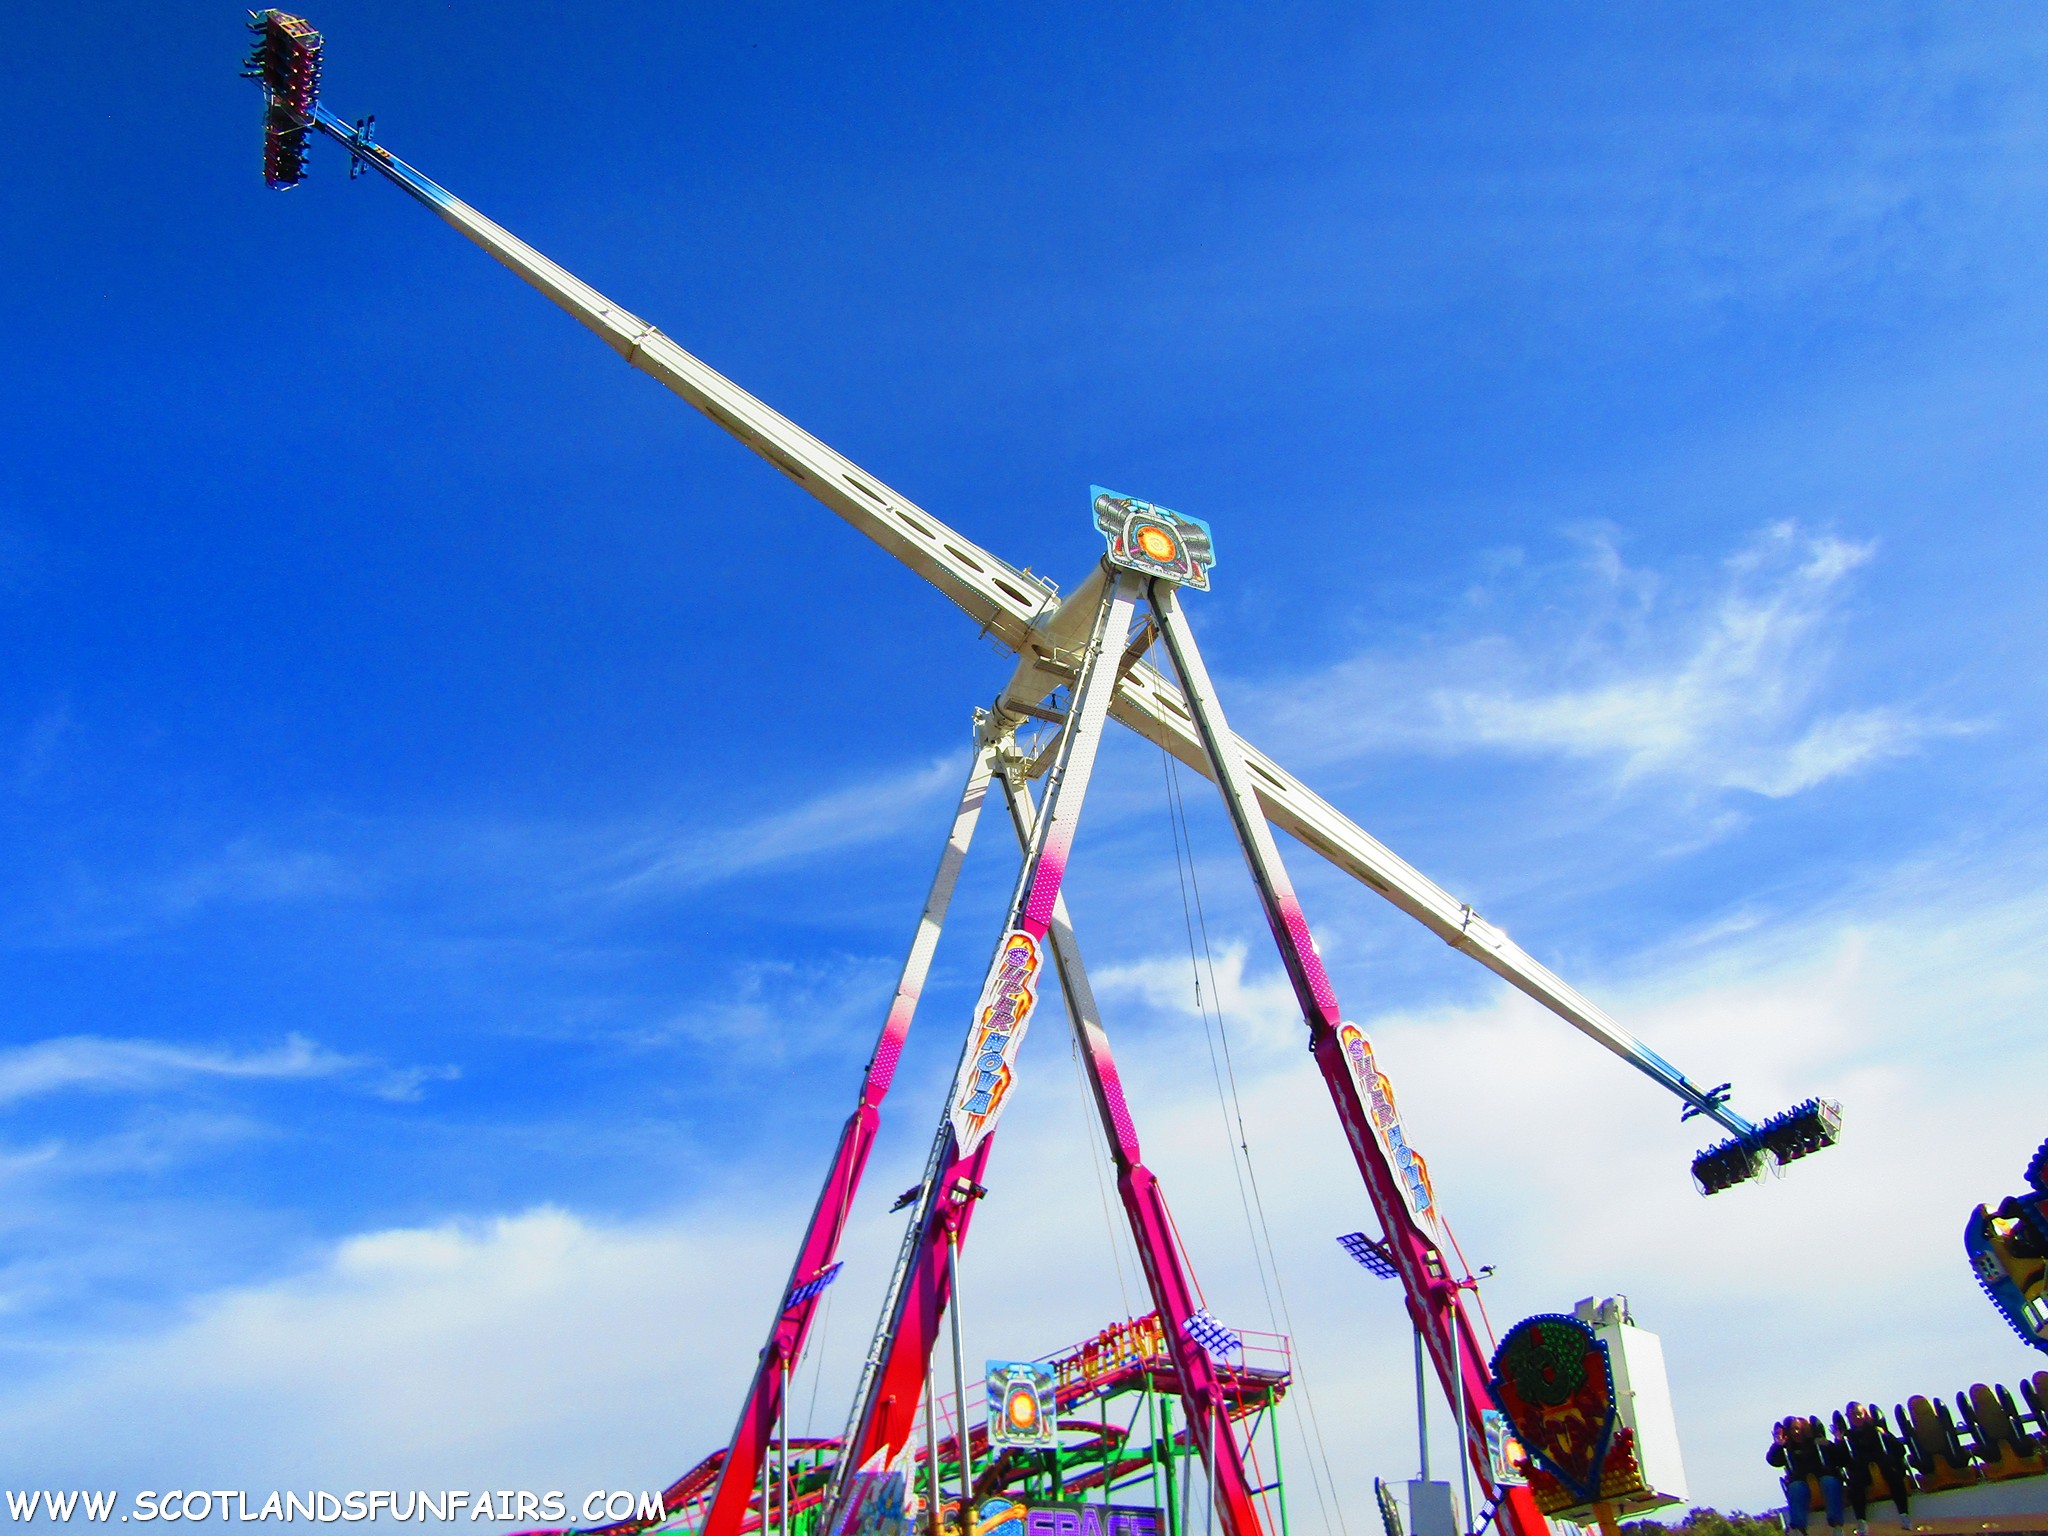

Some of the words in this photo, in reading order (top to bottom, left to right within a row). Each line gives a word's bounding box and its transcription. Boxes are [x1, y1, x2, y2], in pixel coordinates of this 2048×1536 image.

[986, 947, 1029, 1033] SUPER
[962, 1032, 1010, 1115] NOVA
[1348, 1037, 1395, 1129] SUPER
[1386, 1124, 1431, 1214] NOVA
